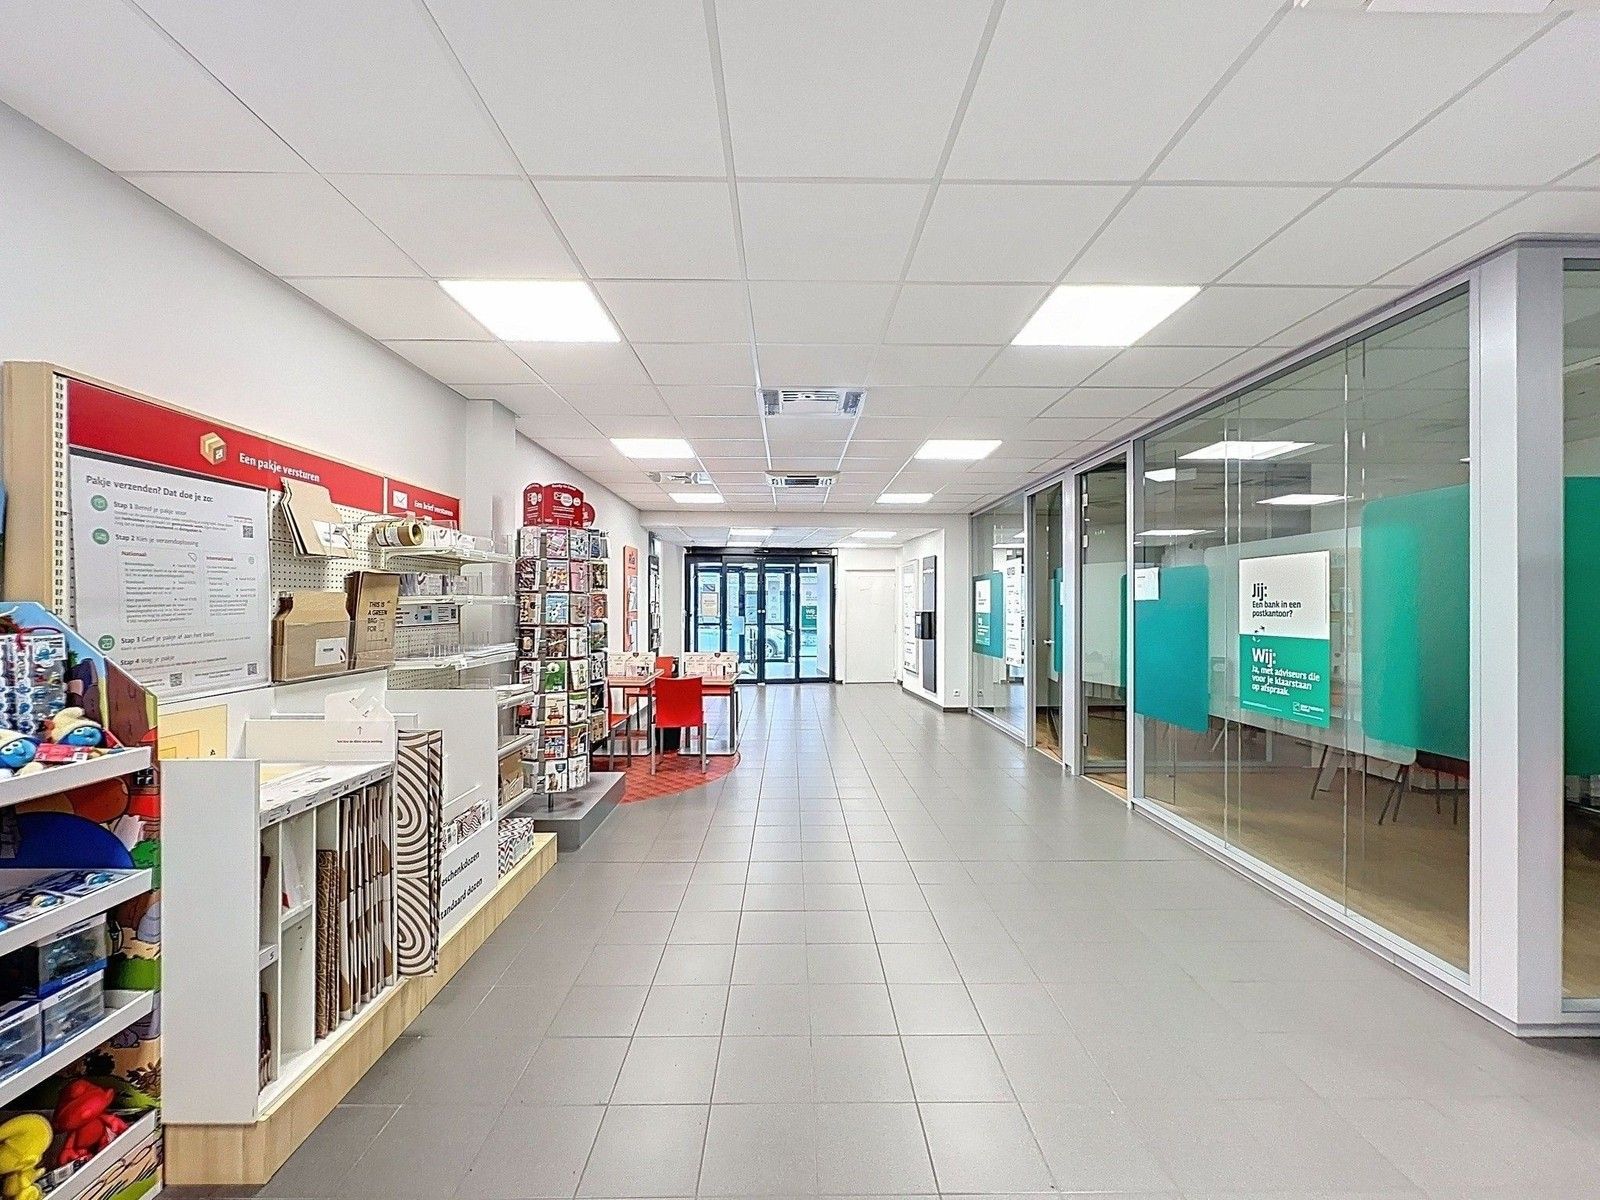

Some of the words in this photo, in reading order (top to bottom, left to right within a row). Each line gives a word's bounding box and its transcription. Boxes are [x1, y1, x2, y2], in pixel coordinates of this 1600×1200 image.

[239, 452, 256, 466] Een
[257, 459, 282, 473] pakje
[282, 466, 320, 482] versturen
[86, 475, 111, 487] Pakje
[113, 481, 161, 494] verzenden?
[163, 488, 177, 497] Dat
[179, 490, 193, 499] doe
[194, 492, 201, 501] je
[113, 501, 128, 510] Stap
[1252, 582, 1267, 601] Jij:
[1264, 600, 1280, 608] bank
[1252, 609, 1293, 618] postkantoor?
[1252, 647, 1276, 667] Wij:
[1252, 675, 1266, 683] voor
[1267, 675, 1273, 685] je
[1275, 676, 1312, 690] klaarstaan
[1261, 667, 1273, 675] met
[1275, 668, 1307, 680] adviseurs
[1308, 672, 1321, 682] die
[1252, 683, 1260, 692] op
[1261, 684, 1290, 696] afspraak.
[441, 851, 480, 887] eschenkdozen
[440, 889, 467, 920] tandaard
[467, 877, 483, 896] dozen
